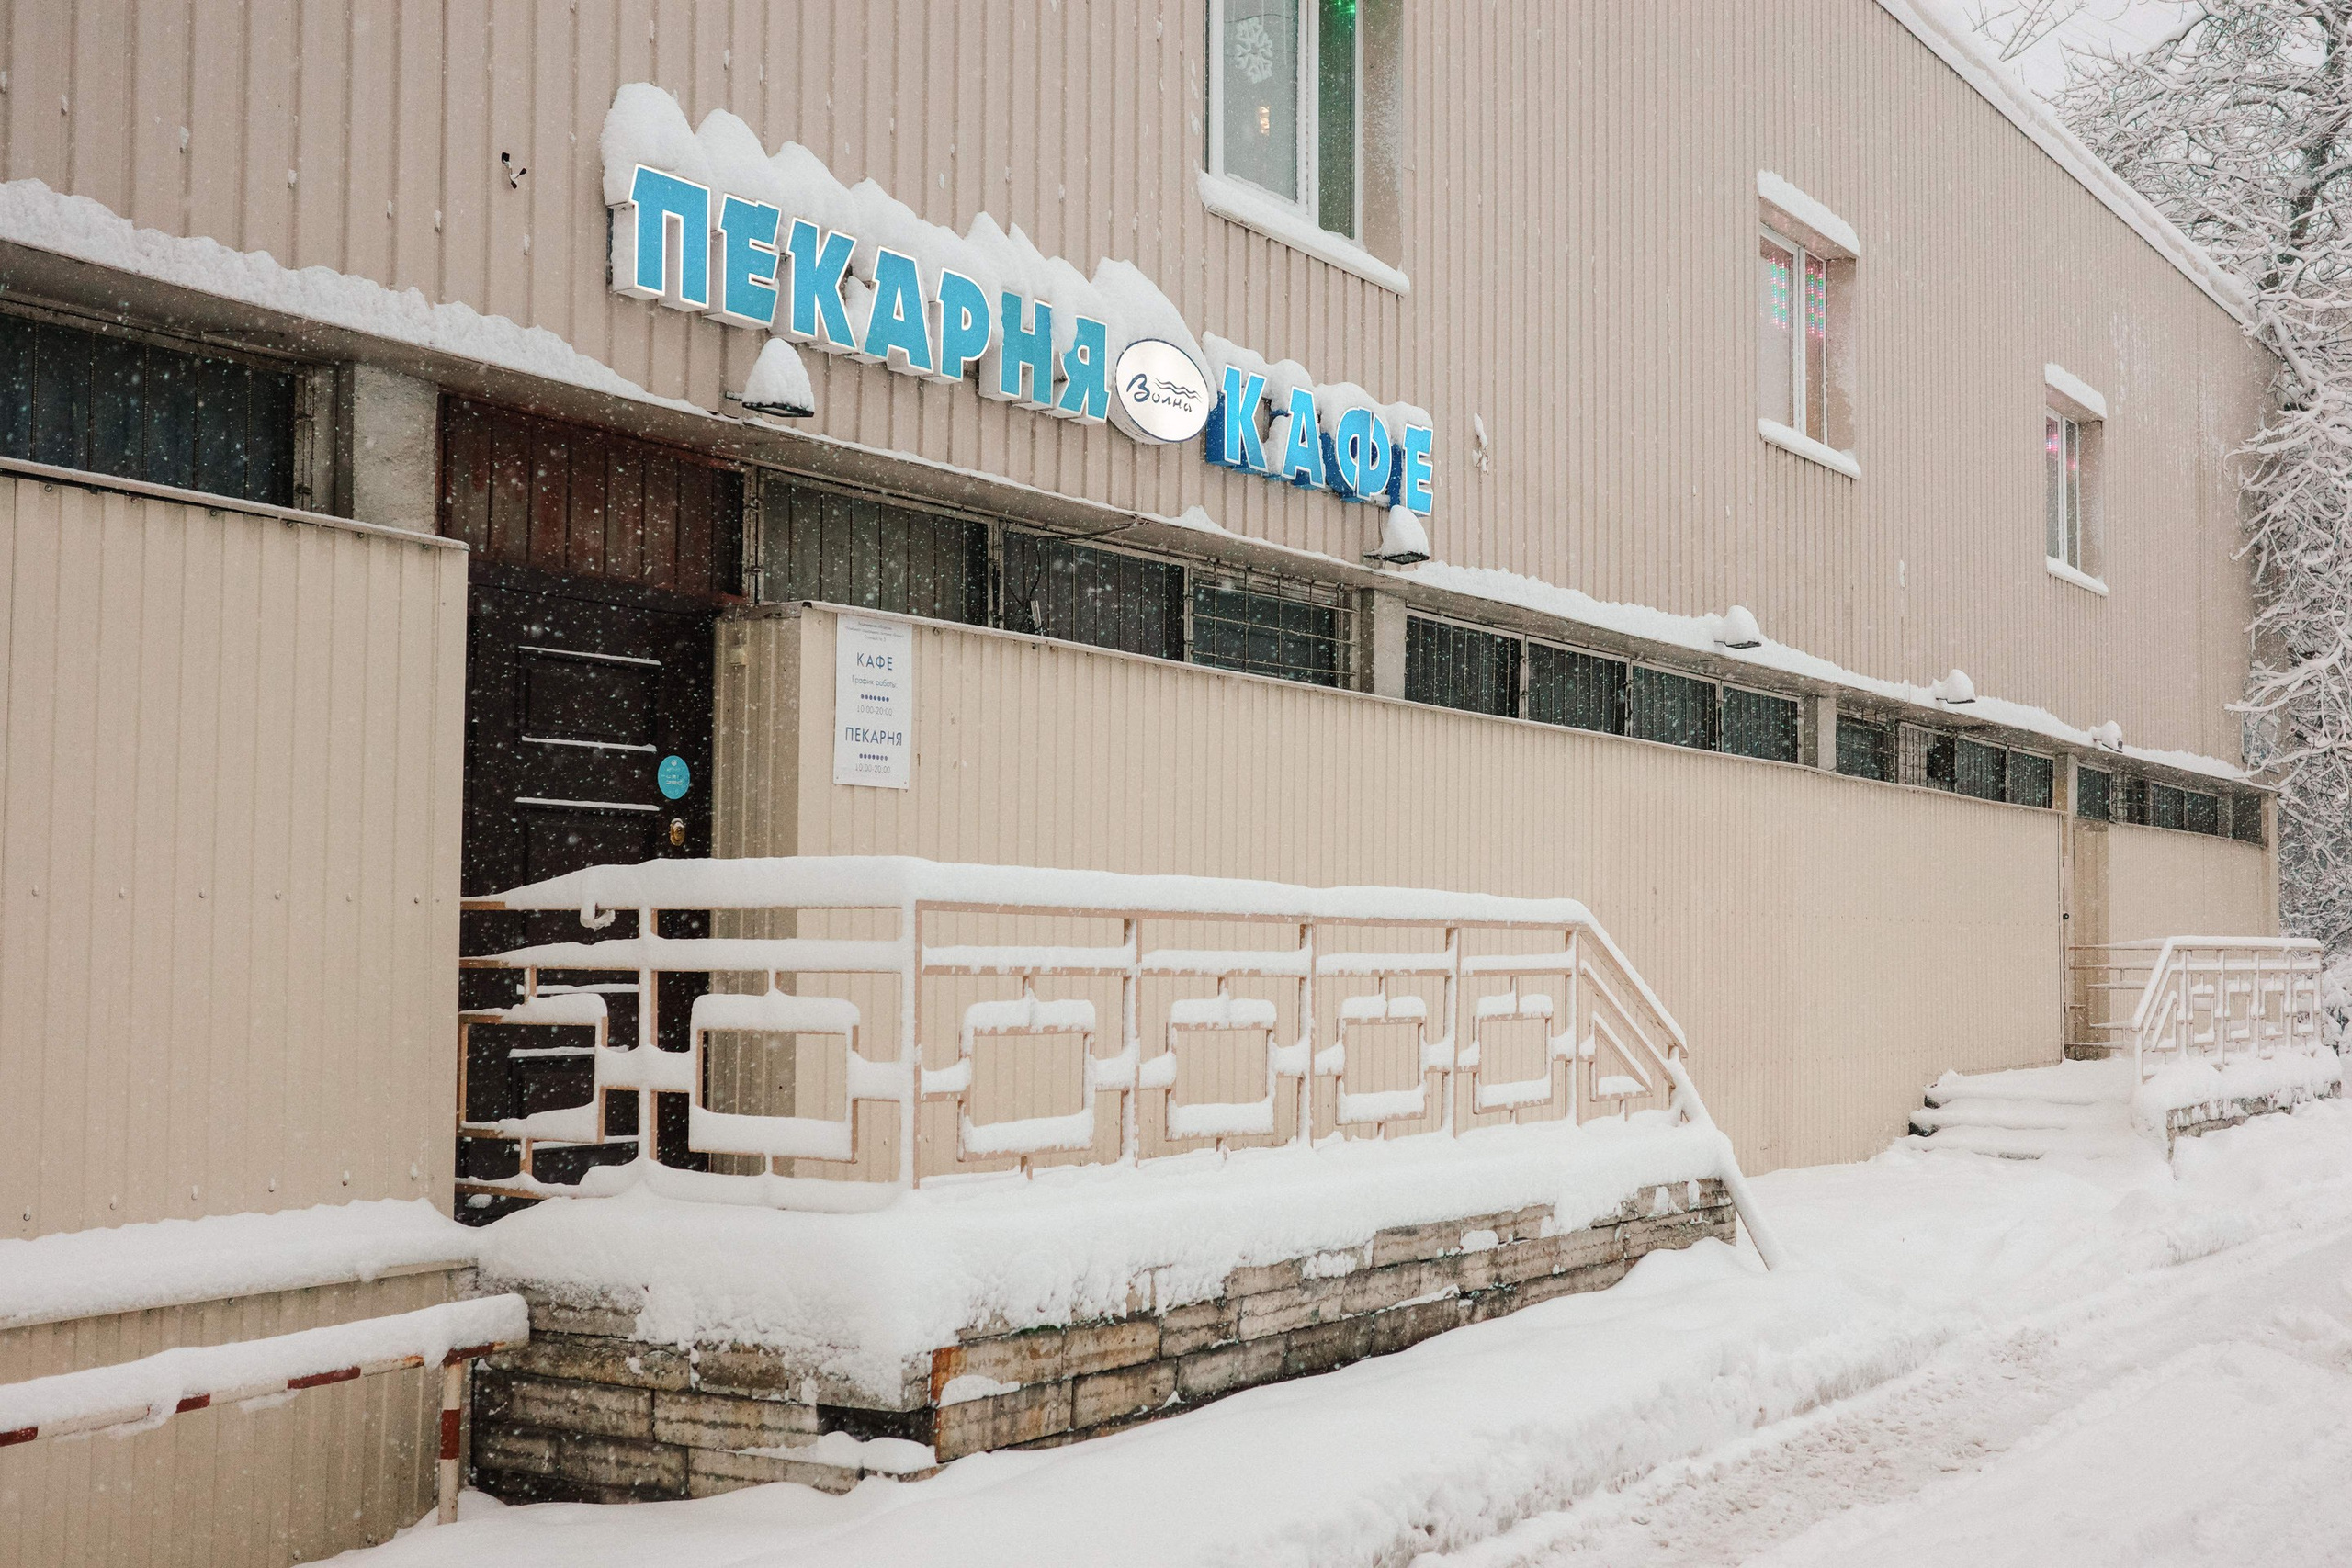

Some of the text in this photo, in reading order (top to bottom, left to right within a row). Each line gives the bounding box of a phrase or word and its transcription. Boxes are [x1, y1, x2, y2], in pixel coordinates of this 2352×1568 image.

[628, 163, 1110, 423] ПЕКАРНЯ
[1126, 373, 1193, 412] Волна
[1221, 364, 1434, 516] КАФЕ
[856, 652, 893, 671] КАФЕ
[852, 674, 874, 687] График
[845, 728, 902, 746] ПЕКАРНЯ
